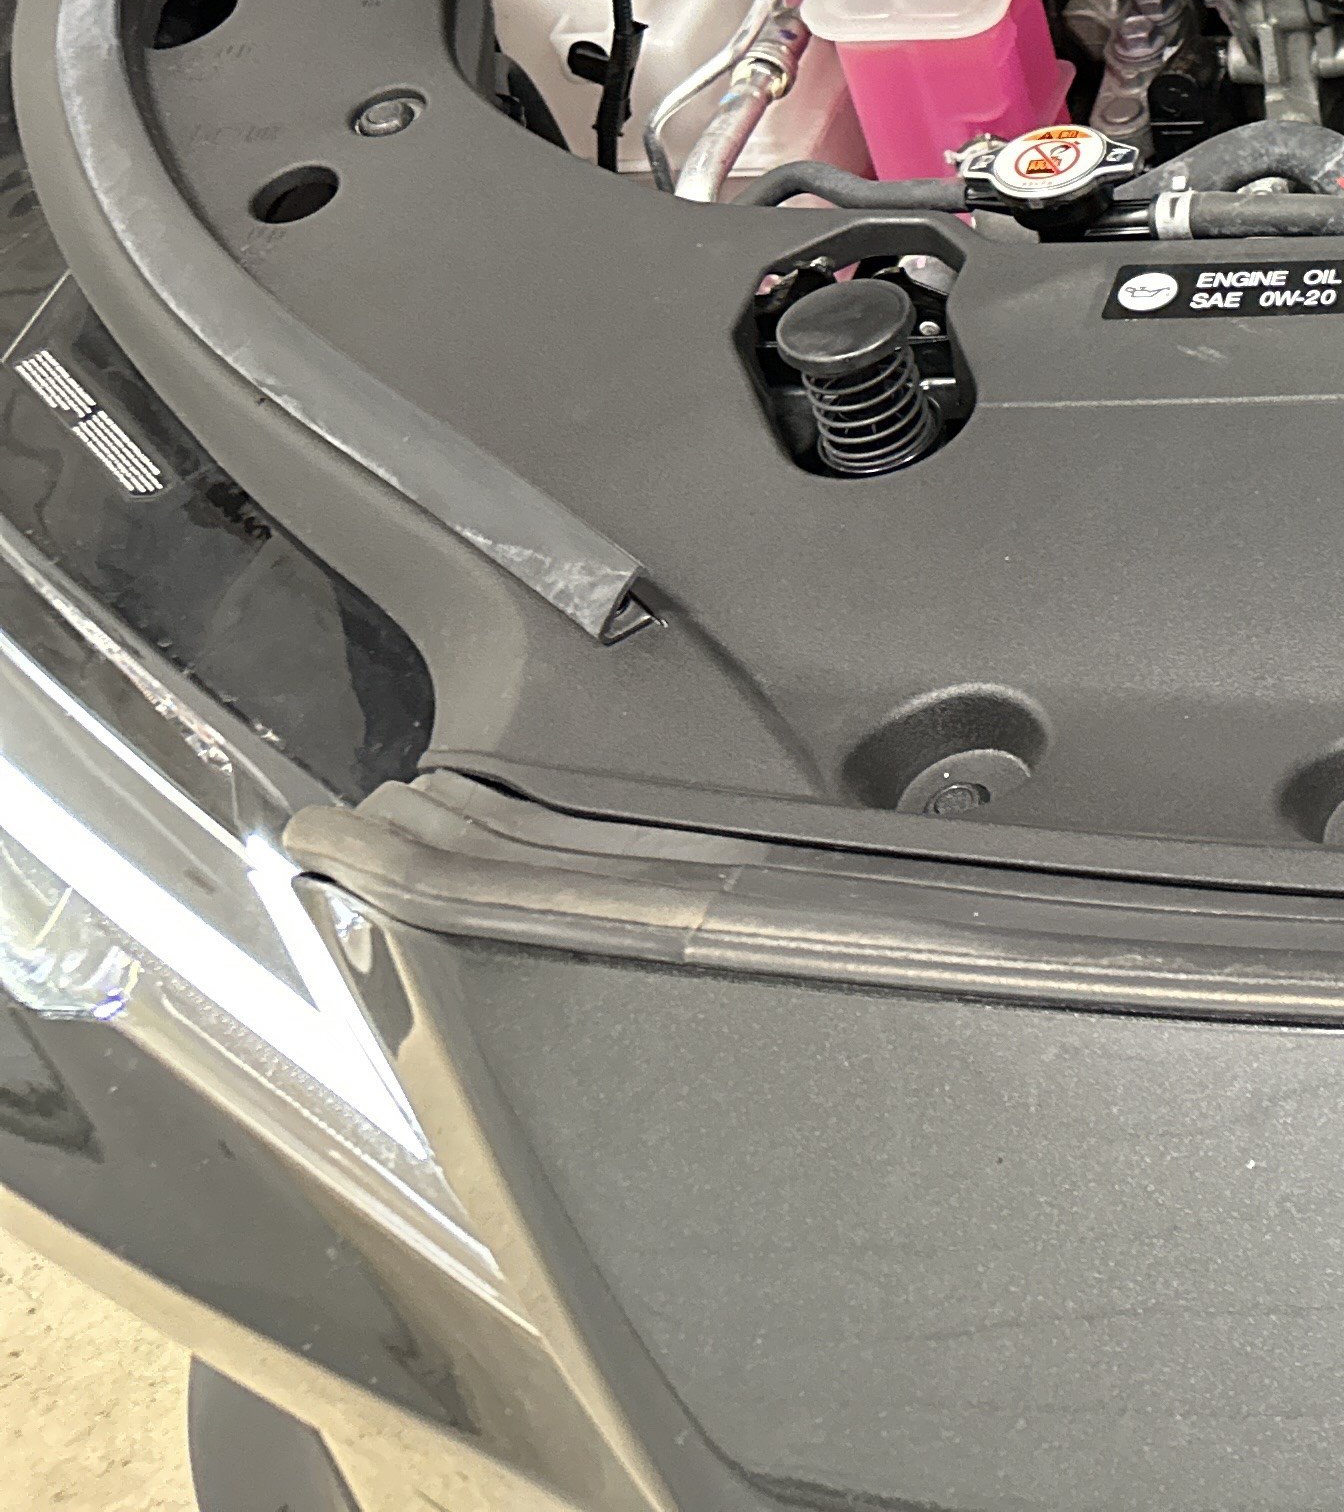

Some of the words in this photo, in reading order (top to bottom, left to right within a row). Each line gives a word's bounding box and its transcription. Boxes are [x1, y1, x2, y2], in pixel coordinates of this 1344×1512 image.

[1196, 270, 1290, 288] ENGINE
[1302, 268, 1343, 286] OIL
[1189, 291, 1244, 309] SAE
[1258, 289, 1338, 308] 0W-20
